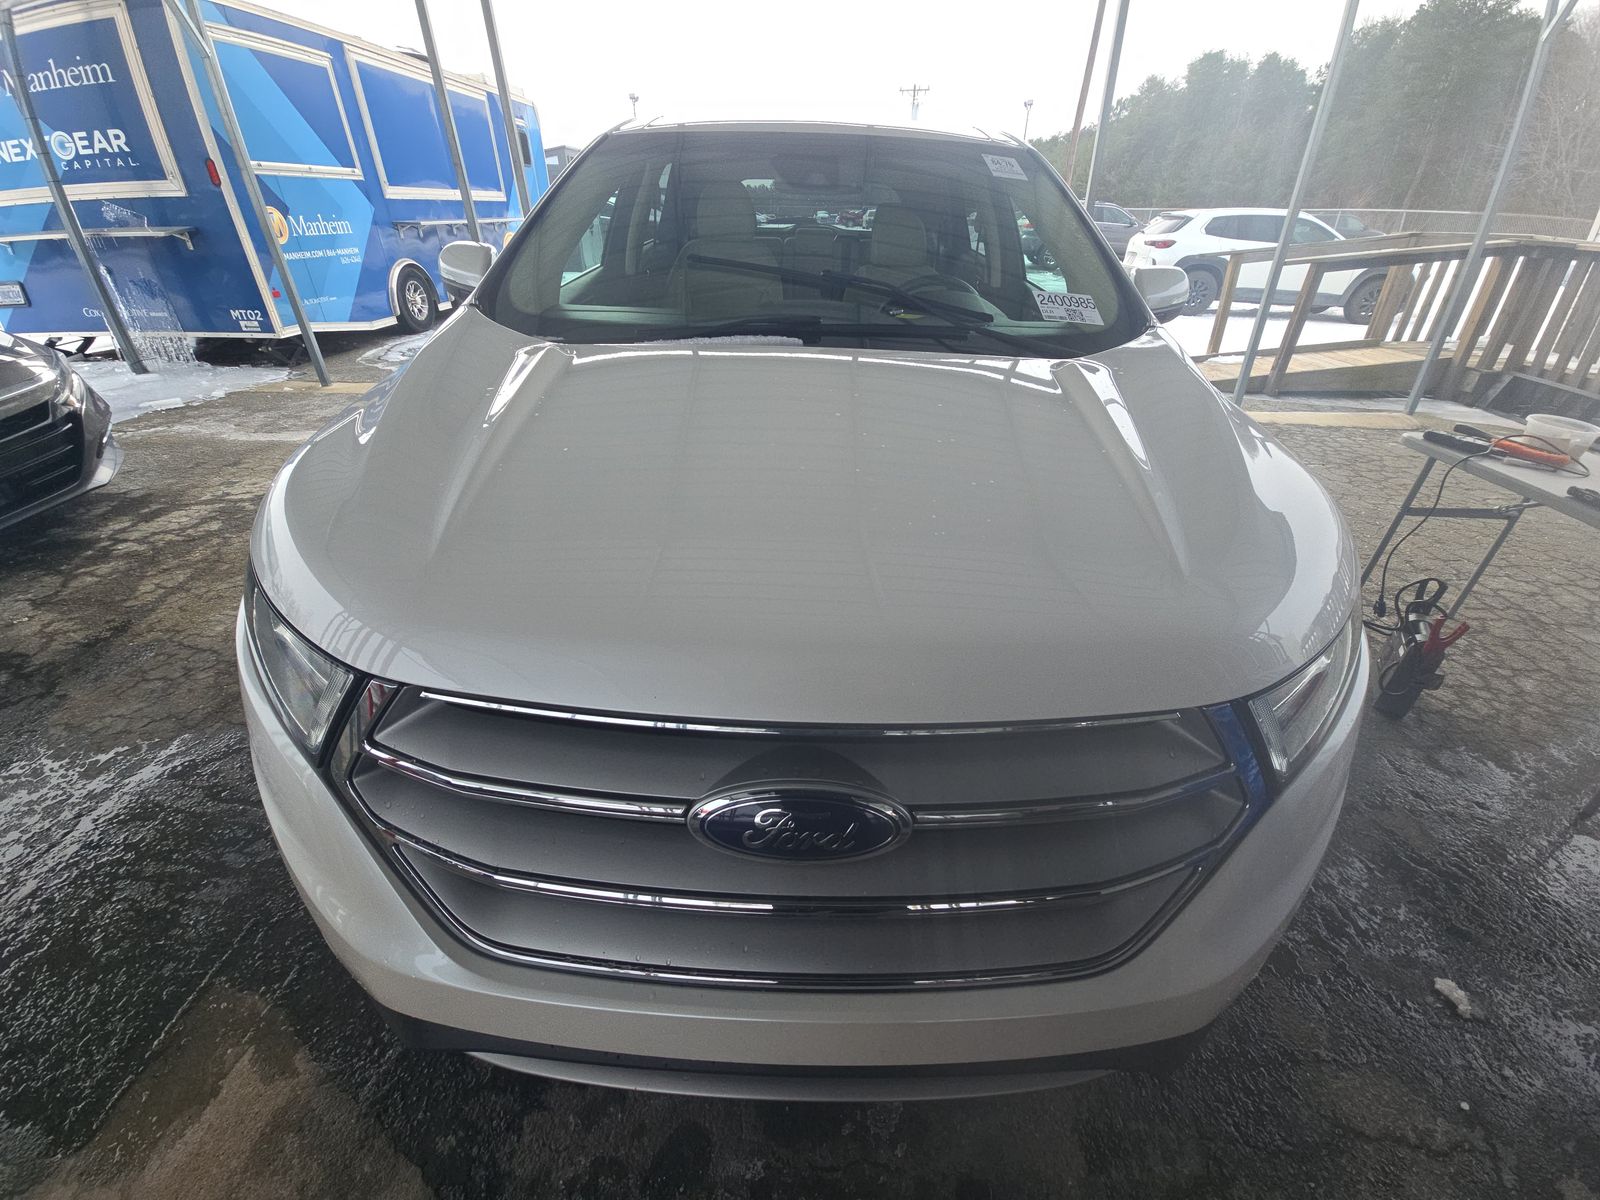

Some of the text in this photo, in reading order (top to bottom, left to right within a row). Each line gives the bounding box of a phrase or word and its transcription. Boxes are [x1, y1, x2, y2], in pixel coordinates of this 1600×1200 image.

[0, 128, 131, 164] NEXGEAR
[288, 213, 353, 238] Manheim
[1037, 293, 1096, 310] 2400985
[743, 808, 860, 848] Ford
